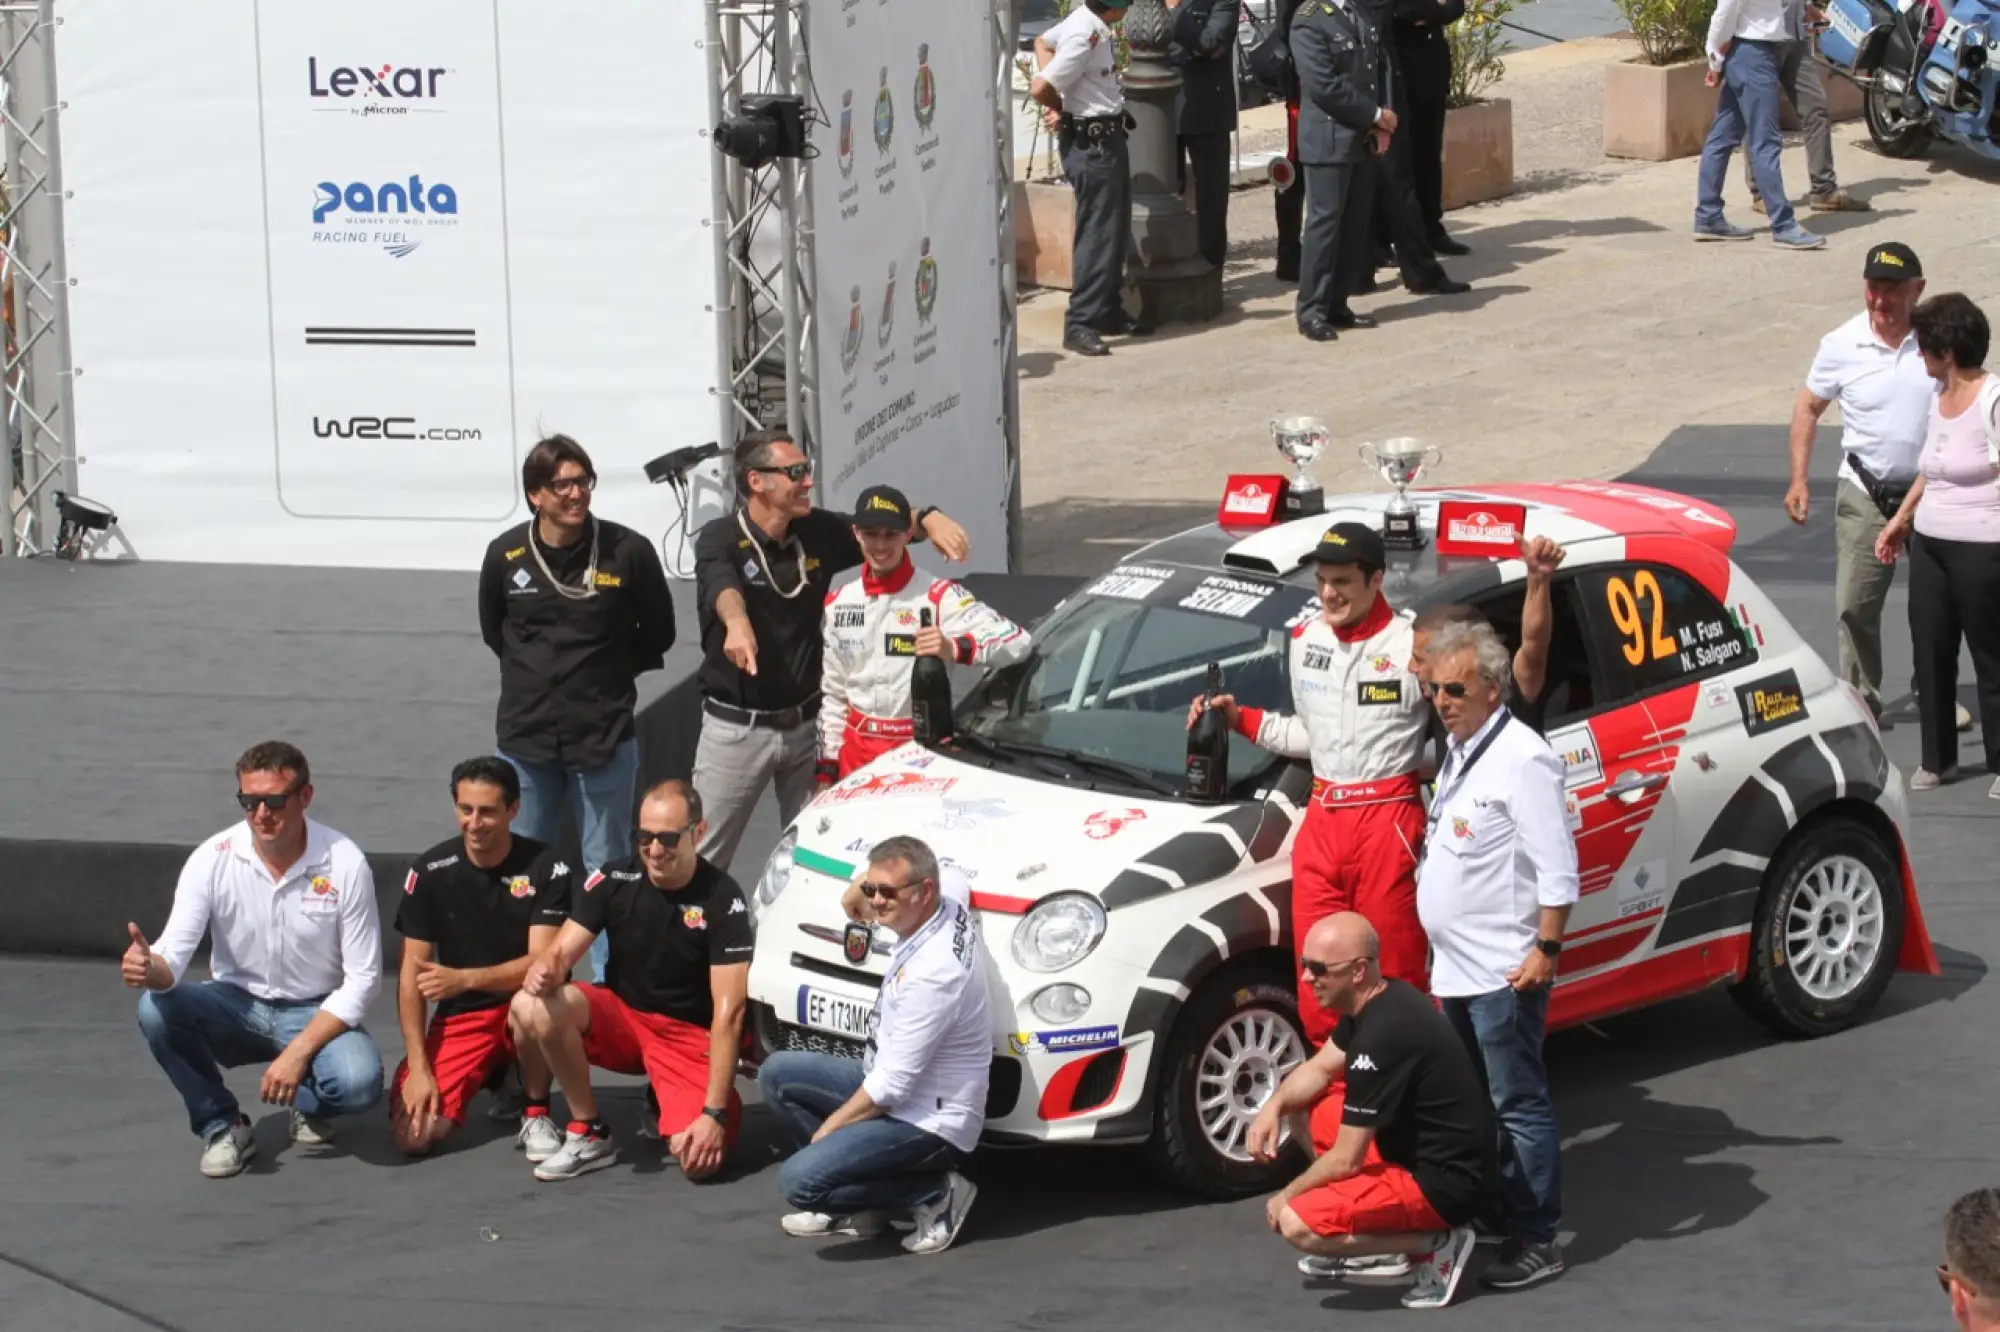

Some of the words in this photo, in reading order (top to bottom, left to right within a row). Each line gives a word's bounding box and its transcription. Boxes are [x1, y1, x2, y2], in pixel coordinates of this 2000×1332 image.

[308, 56, 447, 98] Lexar
[363, 102, 408, 117] Micron
[312, 173, 459, 224] panta
[312, 231, 368, 243] RACING
[373, 232, 409, 243] FUEL
[1606, 569, 1678, 666] 92
[1679, 626, 1697, 648] M.
[1697, 620, 1724, 642] Fusi
[1680, 651, 1696, 673] N.
[1696, 639, 1741, 667] Salgaro
[811, 994, 826, 1024] EF
[1049, 1029, 1118, 1045] MICHELIN
